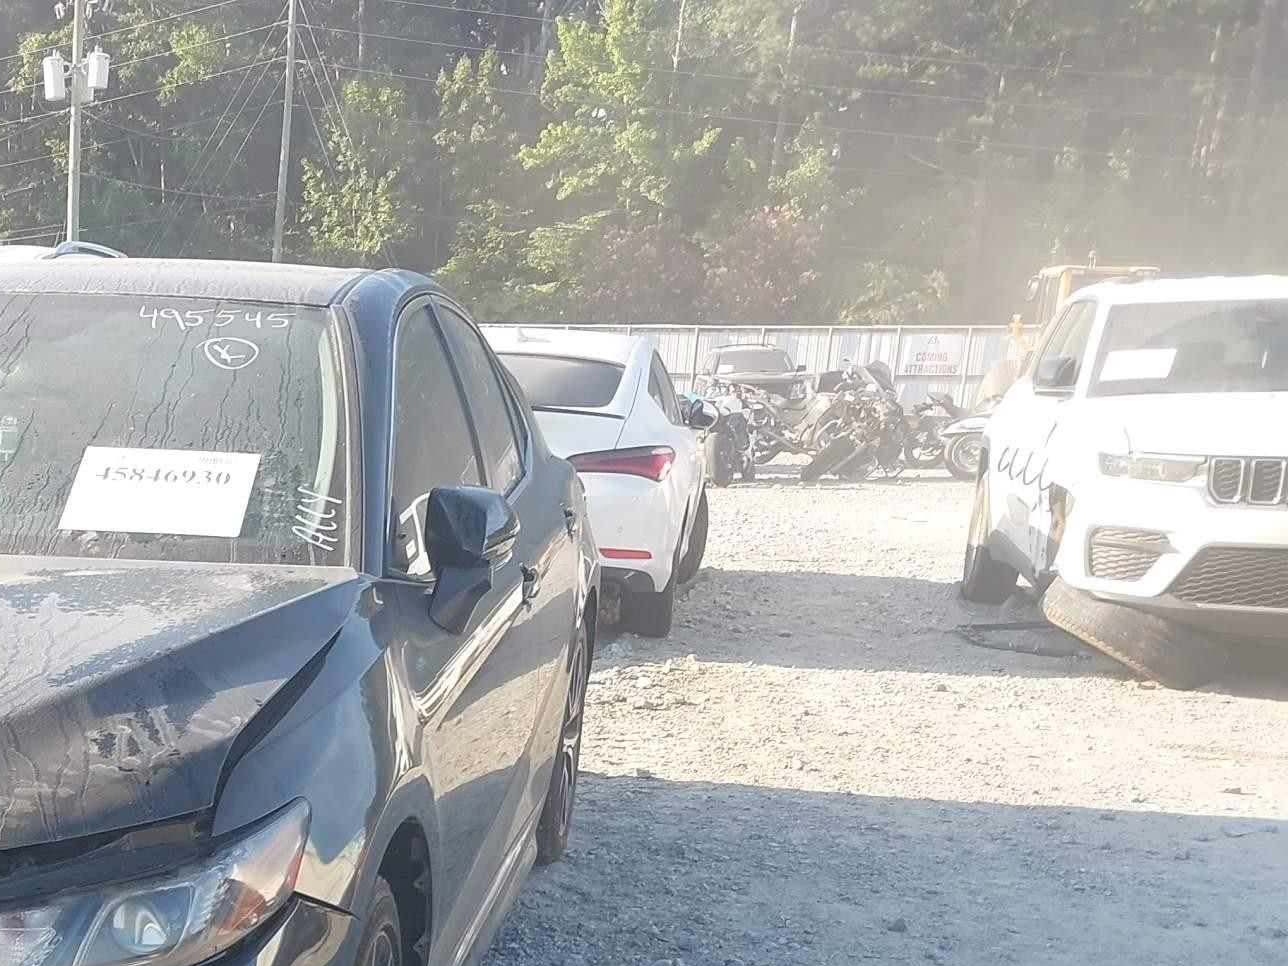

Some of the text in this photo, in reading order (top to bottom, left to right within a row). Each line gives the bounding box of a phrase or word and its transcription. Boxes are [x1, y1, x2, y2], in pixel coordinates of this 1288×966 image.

[140, 305, 296, 330] 495545
[915, 351, 948, 362] COMING
[903, 364, 959, 375] ATTRACTIONS
[96, 466, 231, 486] 45846930
